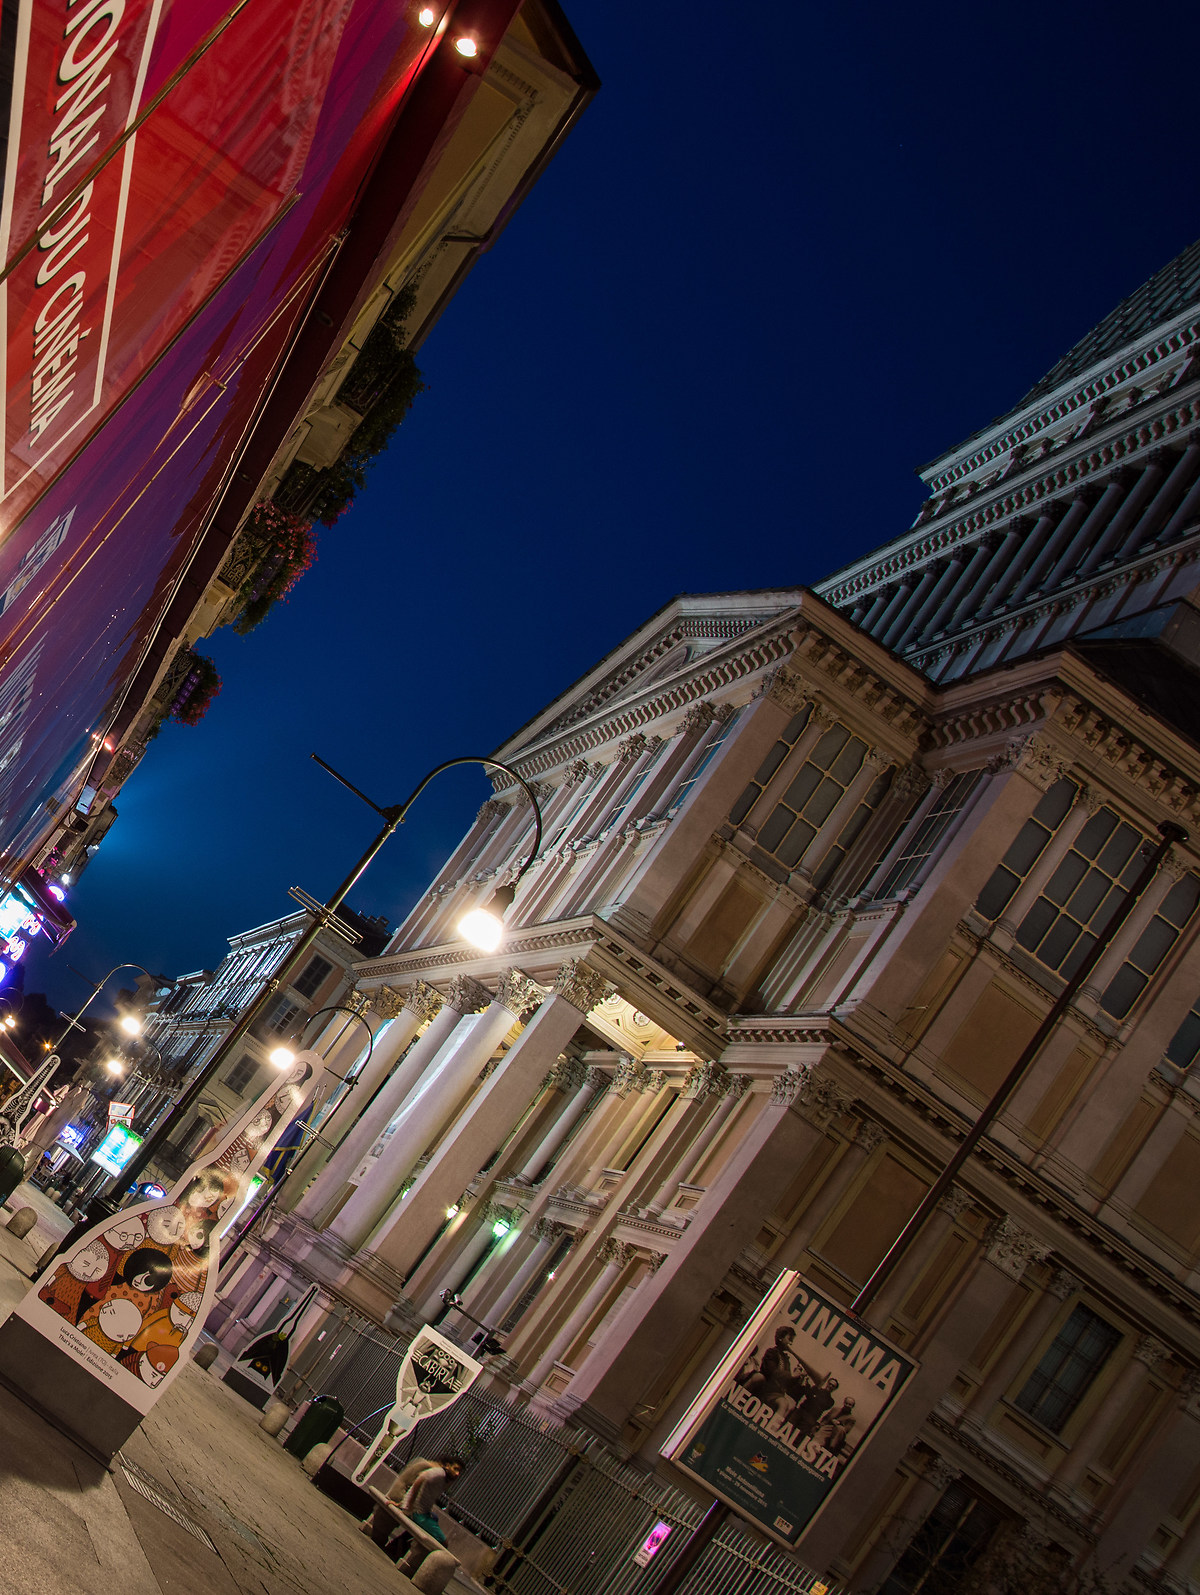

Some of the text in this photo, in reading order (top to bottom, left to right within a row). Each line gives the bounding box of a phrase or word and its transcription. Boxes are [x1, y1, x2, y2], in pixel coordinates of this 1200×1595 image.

[41, 0, 126, 208] IONAL
[35, 180, 94, 288] DU
[29, 271, 91, 448] CINÉMA
[70, 1334, 87, 1350] Cristiano
[73, 1346, 85, 1357] Mole!
[86, 1357, 103, 1372] Edizione
[103, 1371, 112, 1379] 2015
[418, 1355, 455, 1389] CABIRIA
[787, 1288, 901, 1394] CINEMA
[724, 1381, 841, 1479] NEOREALISTA
